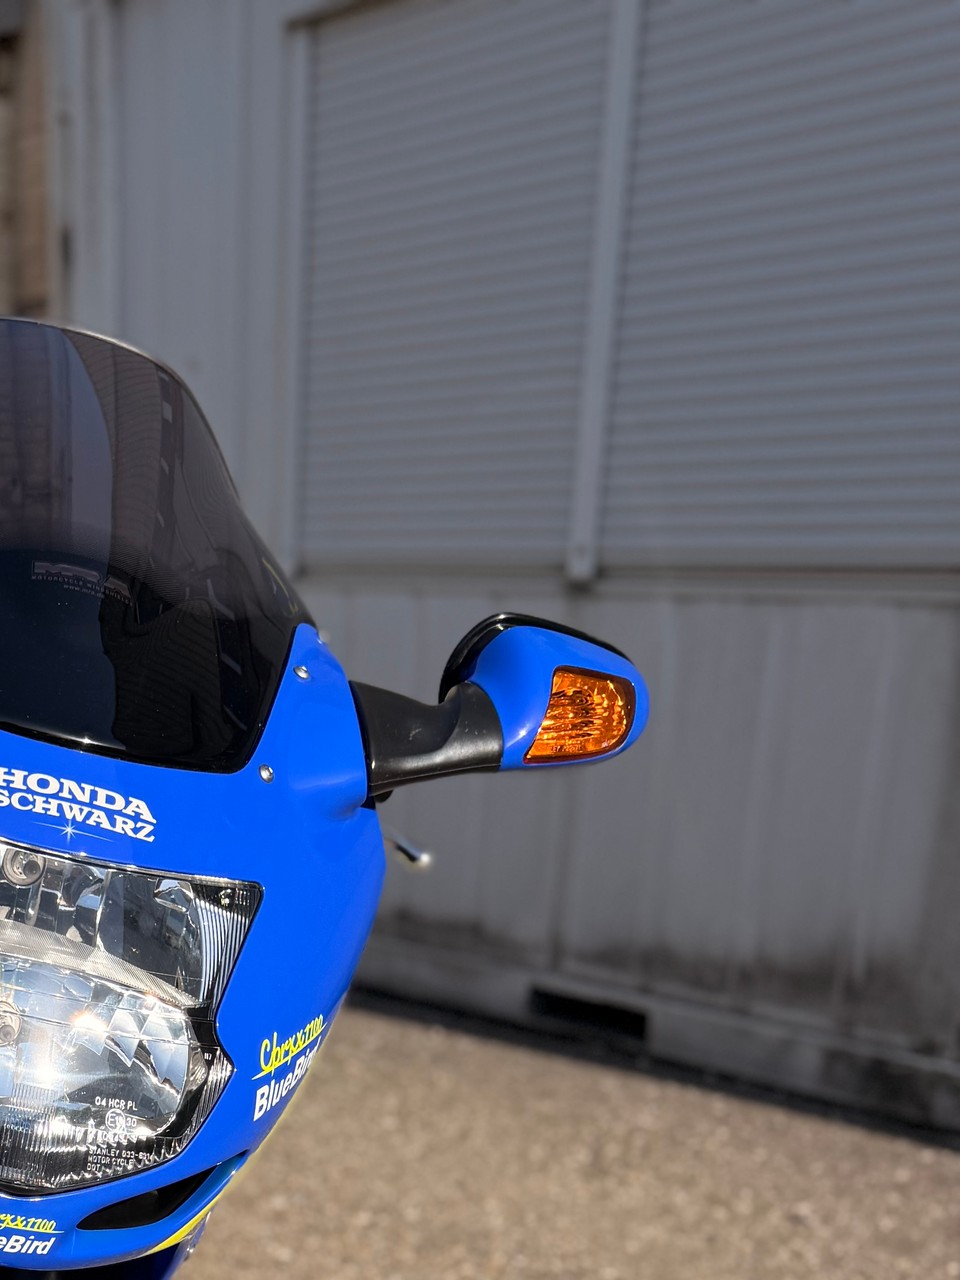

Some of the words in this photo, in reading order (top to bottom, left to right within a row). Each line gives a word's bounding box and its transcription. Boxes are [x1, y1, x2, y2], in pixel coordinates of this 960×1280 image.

[127, 1101, 138, 1111] PL
[88, 1147, 119, 1157] STANLEY
[87, 1155, 110, 1164] MOTOR
